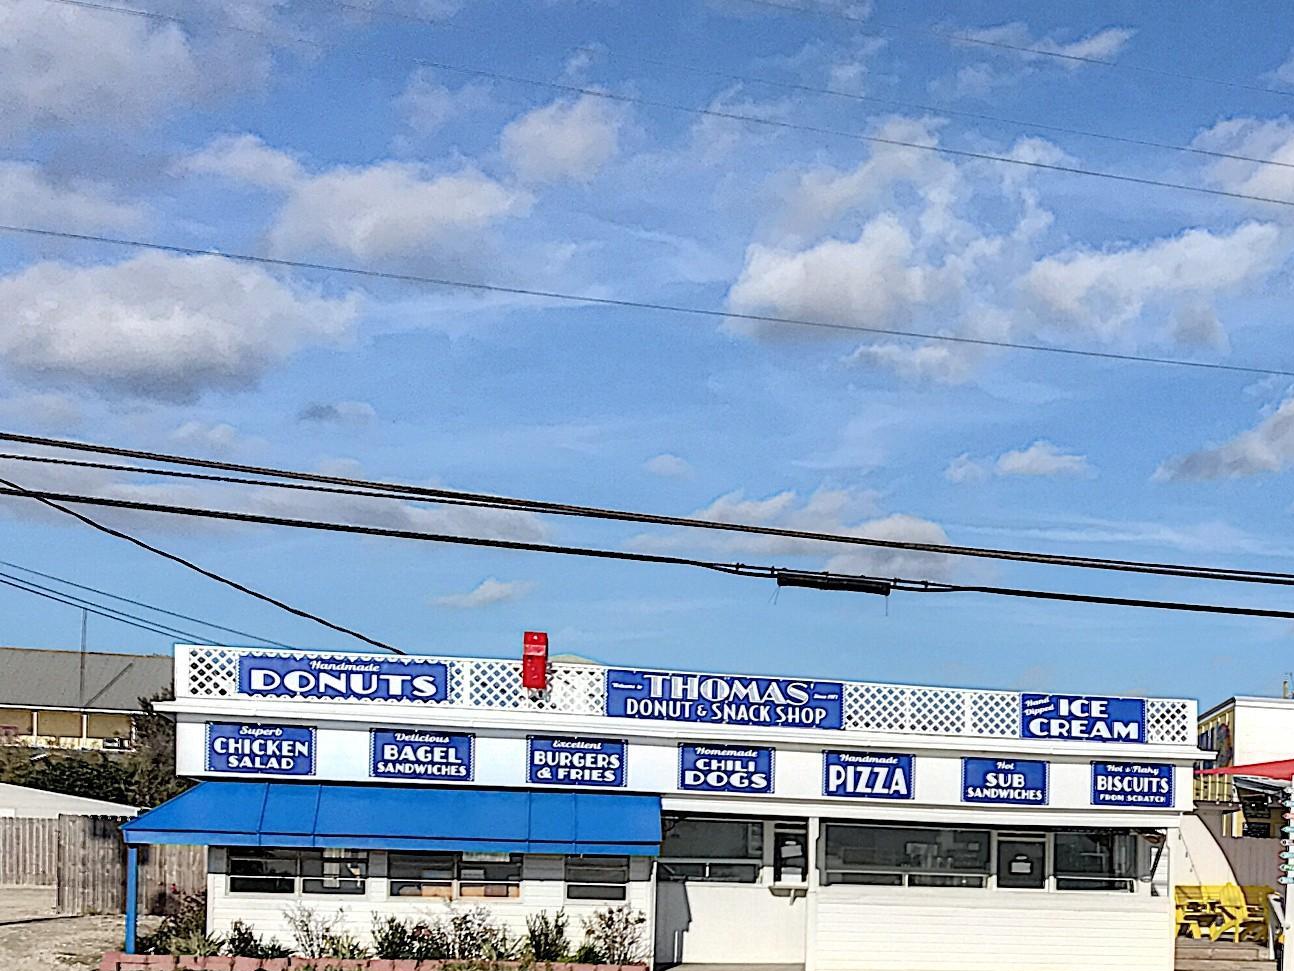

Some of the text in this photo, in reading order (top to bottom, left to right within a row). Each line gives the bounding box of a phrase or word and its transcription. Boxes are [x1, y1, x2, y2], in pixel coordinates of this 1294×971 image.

[310, 660, 380, 673] Handmade
[250, 669, 437, 697] DONUTS
[643, 674, 814, 706] THOMAS'
[1025, 697, 1050, 708] Hand
[1058, 698, 1109, 718] ICE
[626, 698, 826, 724] DONUT & SNACK SHOP
[1024, 705, 1055, 716] Dipped
[240, 725, 283, 738] Superb
[1029, 718, 1139, 740] CREAM
[395, 732, 450, 744] Delicious
[553, 740, 602, 750] Excellent
[213, 737, 309, 758] CHICKEN
[384, 745, 462, 764] BAGEL
[696, 747, 758, 758] Homemade
[228, 754, 294, 770] SALAD
[534, 751, 620, 768] BURGERS
[696, 758, 755, 772] CHILI
[839, 753, 899, 764] Handmade
[997, 761, 1015, 770] Hot
[377, 761, 467, 777] SANDWICHES
[537, 767, 616, 782] & FRIES
[1106, 764, 1123, 774] Hot
[685, 771, 768, 789] DOGS
[829, 765, 908, 795] PIZZA
[985, 773, 1025, 788] SUB
[1097, 776, 1168, 794] BISCUITS
[967, 787, 1043, 800] SANDWICHES
[1100, 794, 1166, 803] FROM SCRATCH
